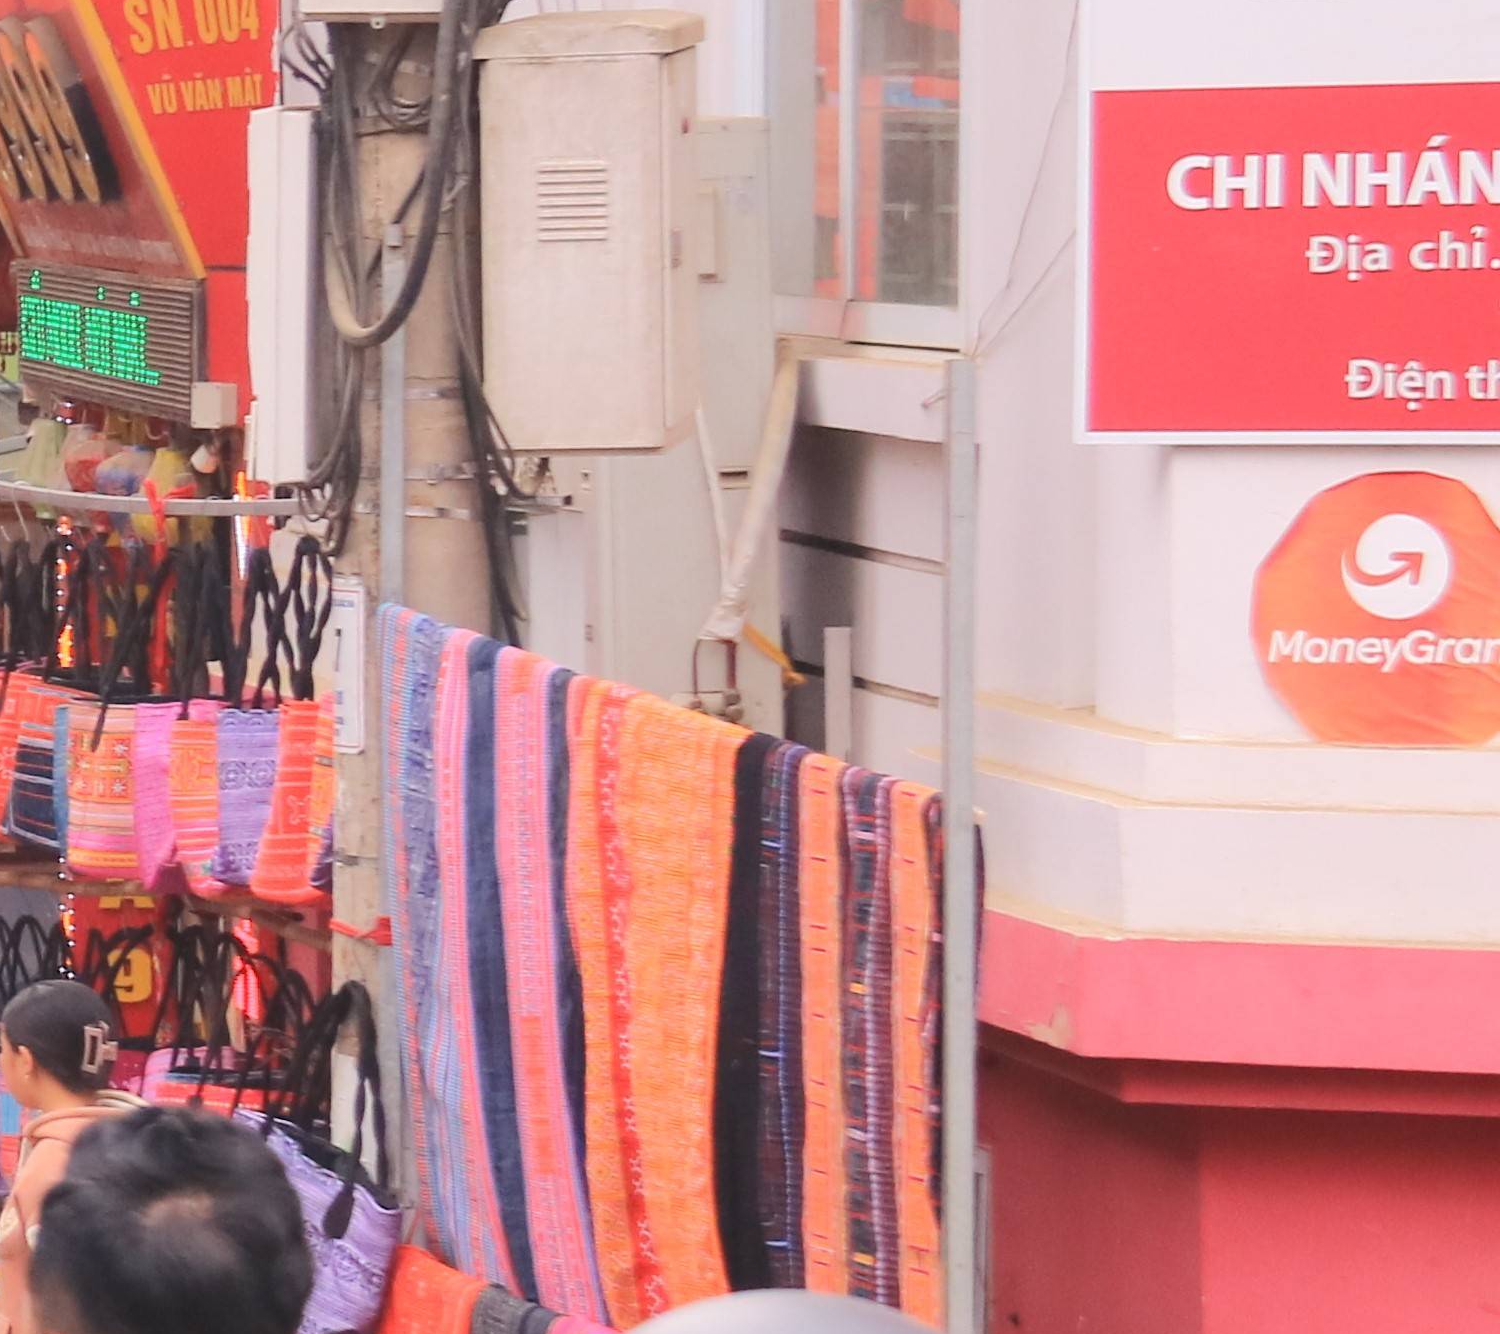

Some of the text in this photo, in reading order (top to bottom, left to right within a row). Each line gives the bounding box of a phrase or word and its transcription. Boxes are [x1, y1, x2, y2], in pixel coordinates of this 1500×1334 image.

[1165, 133, 1500, 211] CHI NHÁN
[1304, 233, 1392, 282] Địa
[1343, 357, 1456, 412] Điện
